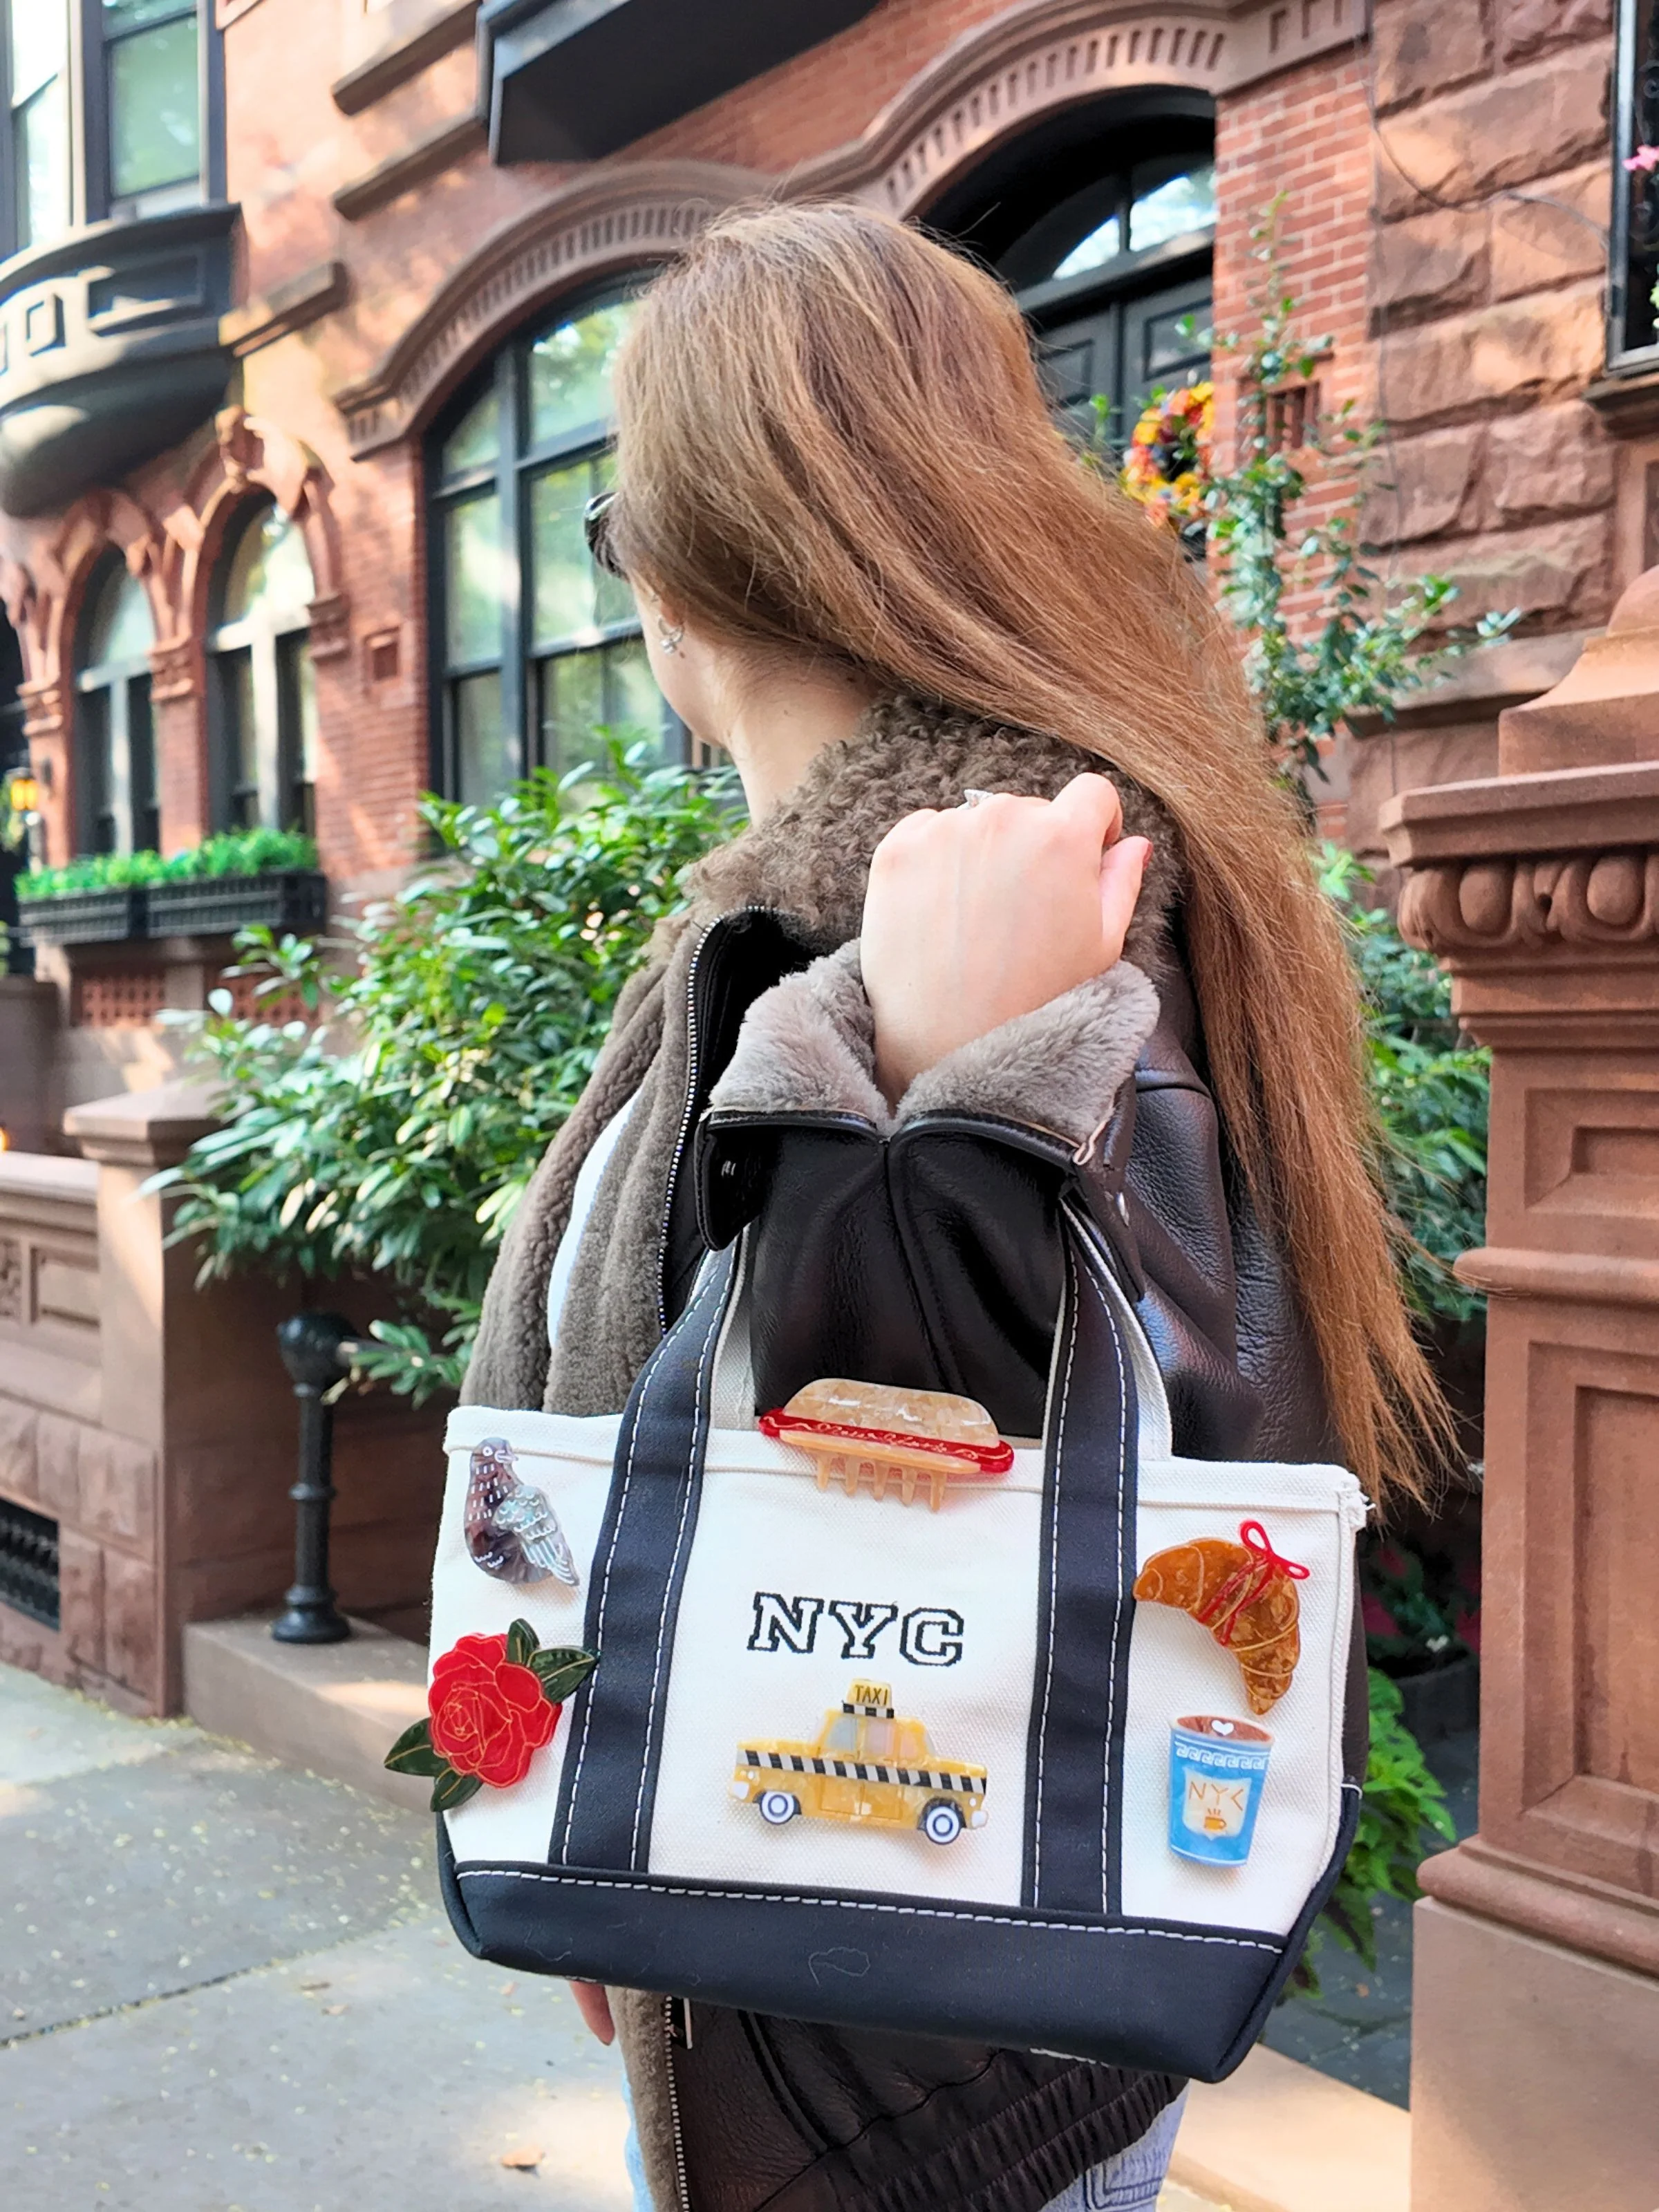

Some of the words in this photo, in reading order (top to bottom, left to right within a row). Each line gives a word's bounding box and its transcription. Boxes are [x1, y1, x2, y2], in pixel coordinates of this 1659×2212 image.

[747, 1591, 964, 1667] NYC
[854, 1684, 888, 1706] TAXI
[1188, 1781, 1244, 1812] NYC
